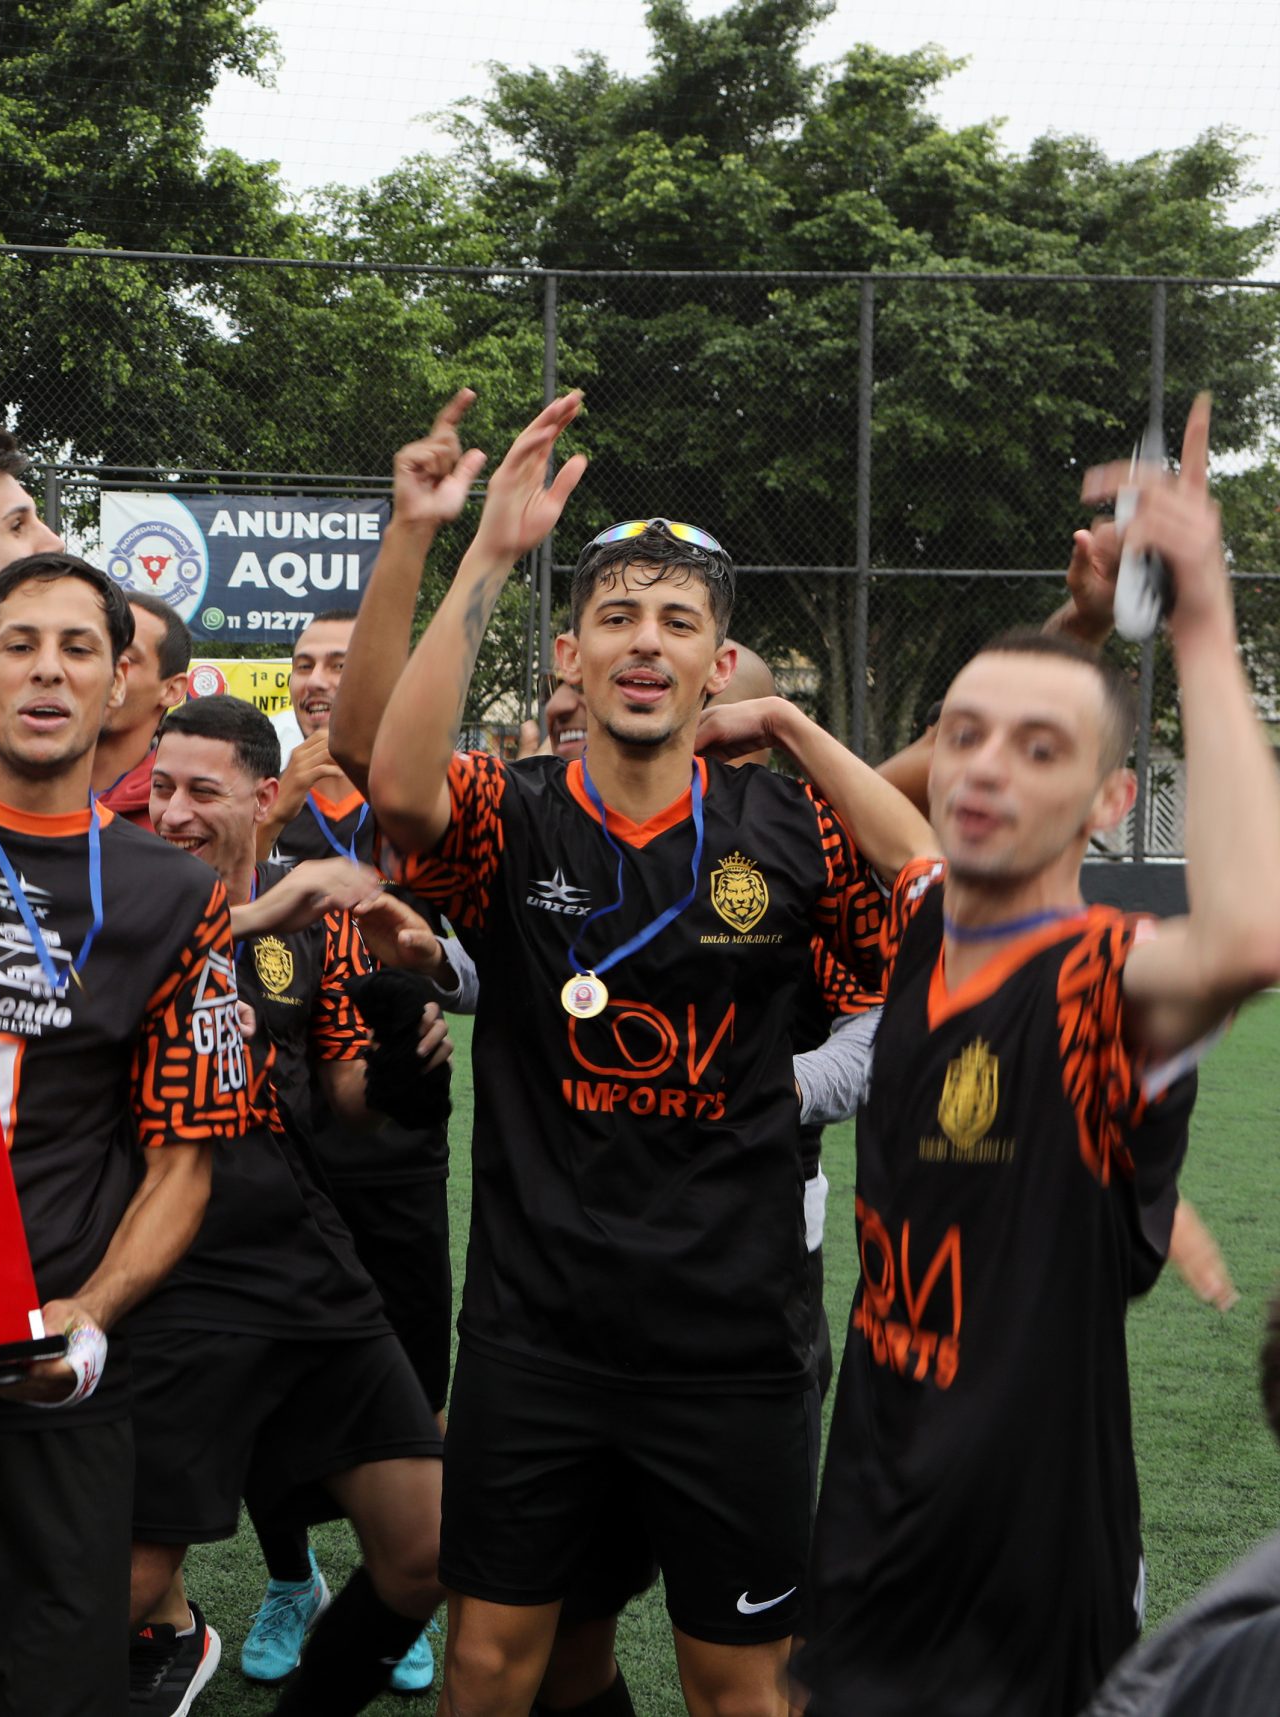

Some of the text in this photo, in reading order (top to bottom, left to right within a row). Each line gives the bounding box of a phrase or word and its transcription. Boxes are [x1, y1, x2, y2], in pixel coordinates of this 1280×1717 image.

[208, 509, 381, 540] ANUNCIE
[228, 552, 360, 597] AQUI
[227, 615, 241, 629] 11
[253, 695, 294, 711] INTE
[700, 932, 730, 944] UNIÃO
[731, 934, 770, 945] MORADA
[562, 1079, 726, 1121] IMPORTS
